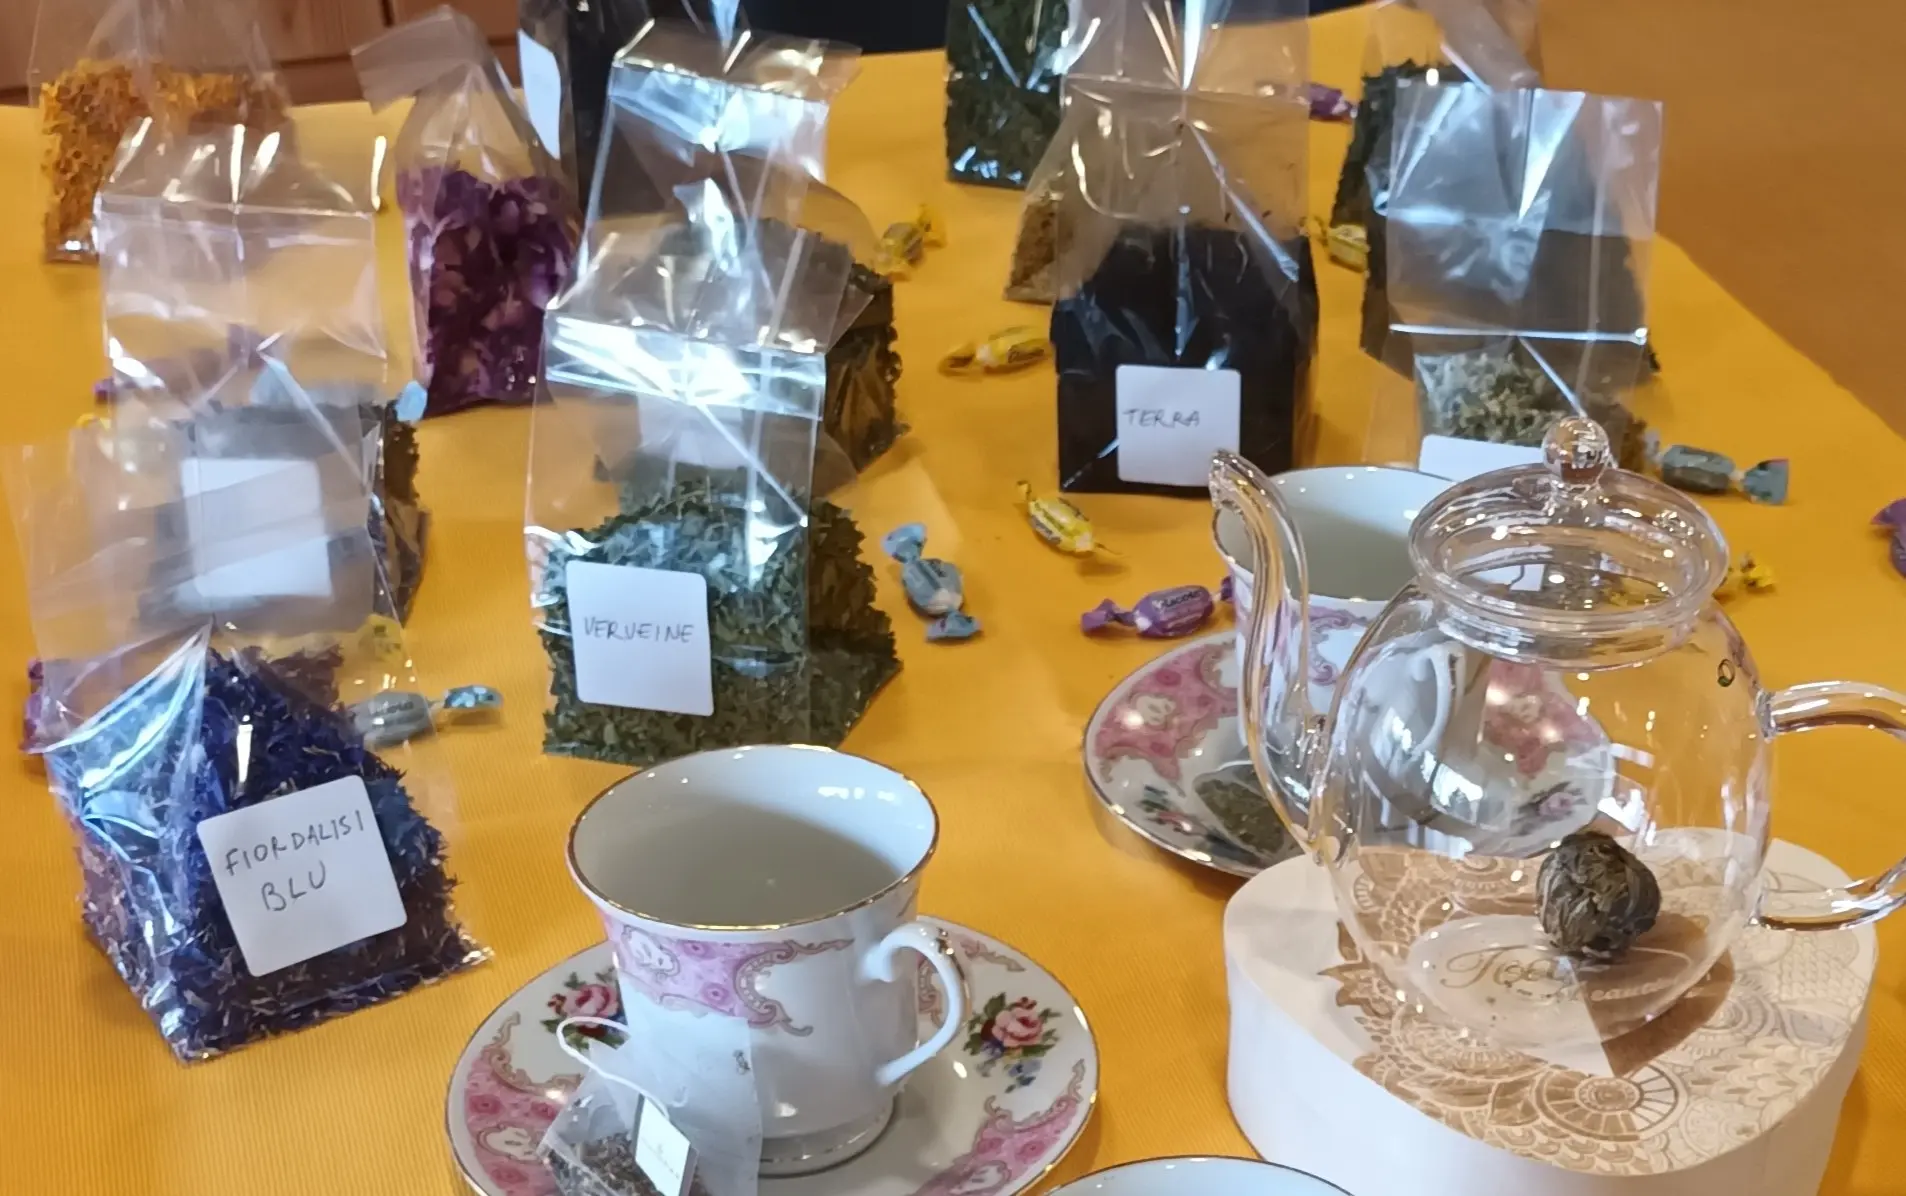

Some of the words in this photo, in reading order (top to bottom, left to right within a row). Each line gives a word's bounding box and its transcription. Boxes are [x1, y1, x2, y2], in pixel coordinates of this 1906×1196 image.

[1122, 408, 1200, 429] TERRA
[583, 615, 695, 643] VERVEINE
[225, 809, 364, 877] FIORDALISI
[261, 860, 327, 912] BLU
